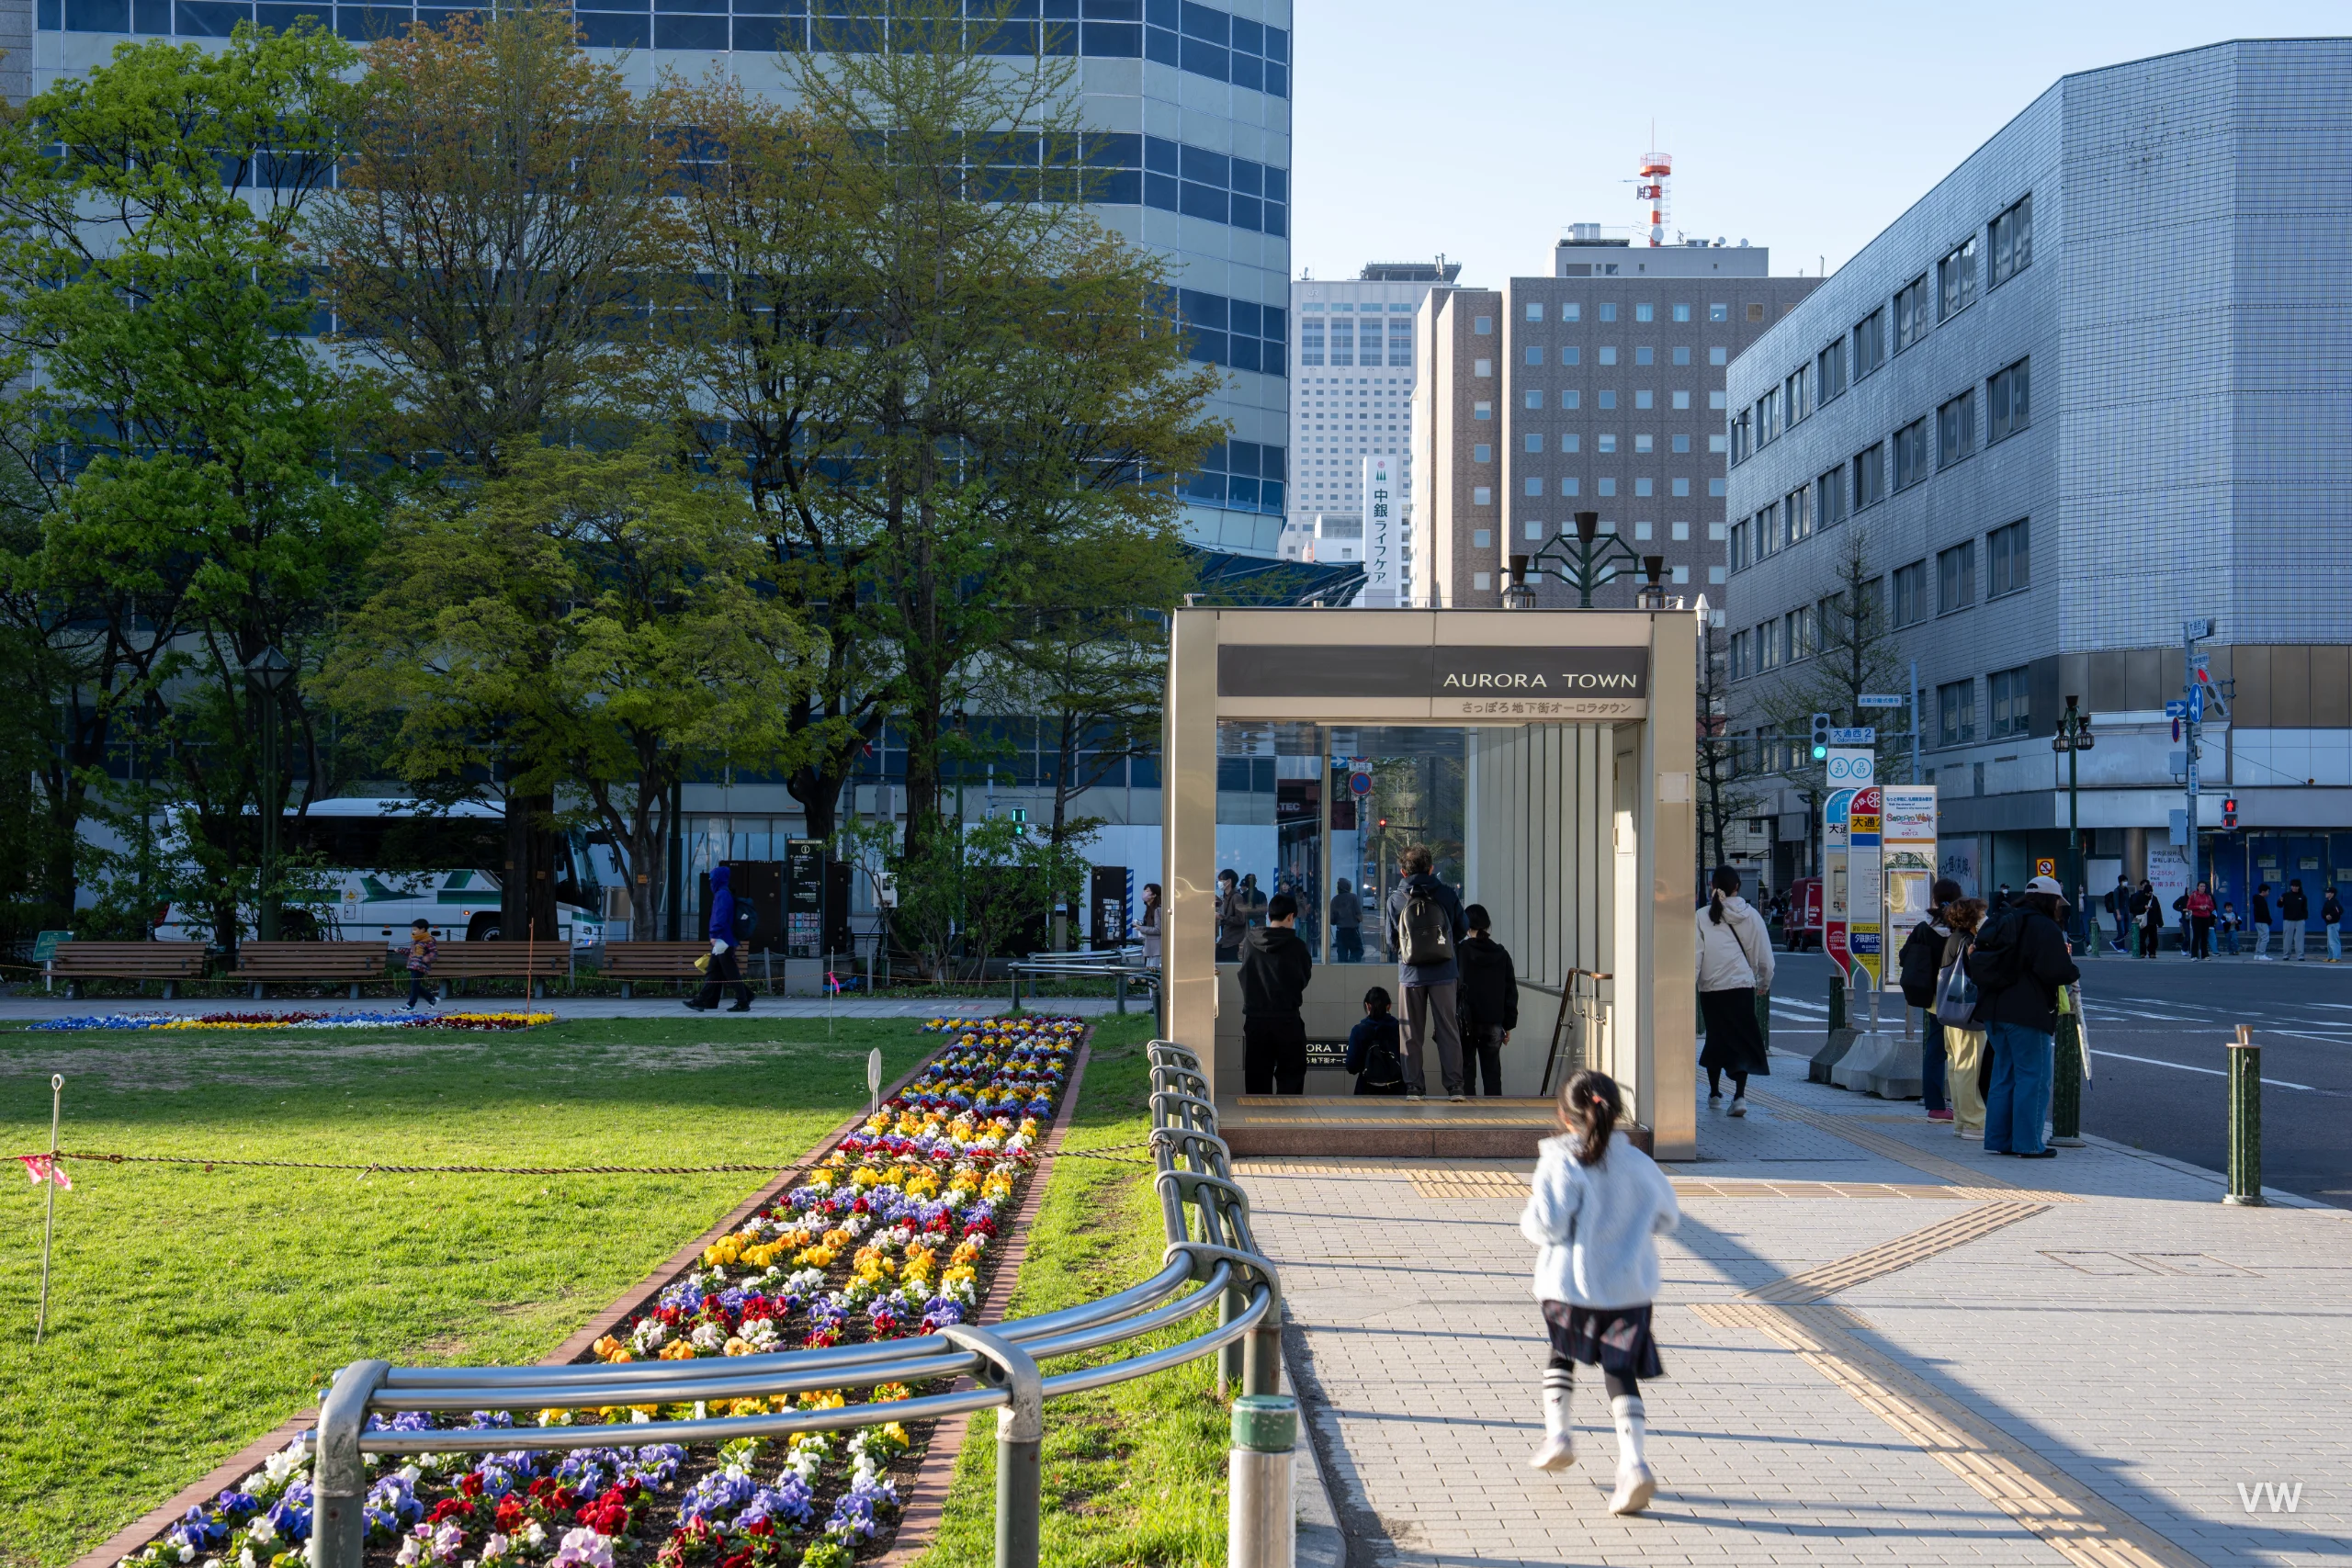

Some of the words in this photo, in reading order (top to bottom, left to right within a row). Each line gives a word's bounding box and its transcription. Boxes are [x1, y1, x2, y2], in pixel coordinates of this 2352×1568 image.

[1374, 488, 1388, 584] 中銀ライフケア
[1443, 673, 1548, 688] AURORA
[1562, 673, 1637, 689] TOWN
[1462, 701, 1633, 715] さっぽろ地下街オーロラタウン
[1853, 797, 1867, 811] 夕鉄
[1886, 813, 1915, 823] Sapporo
